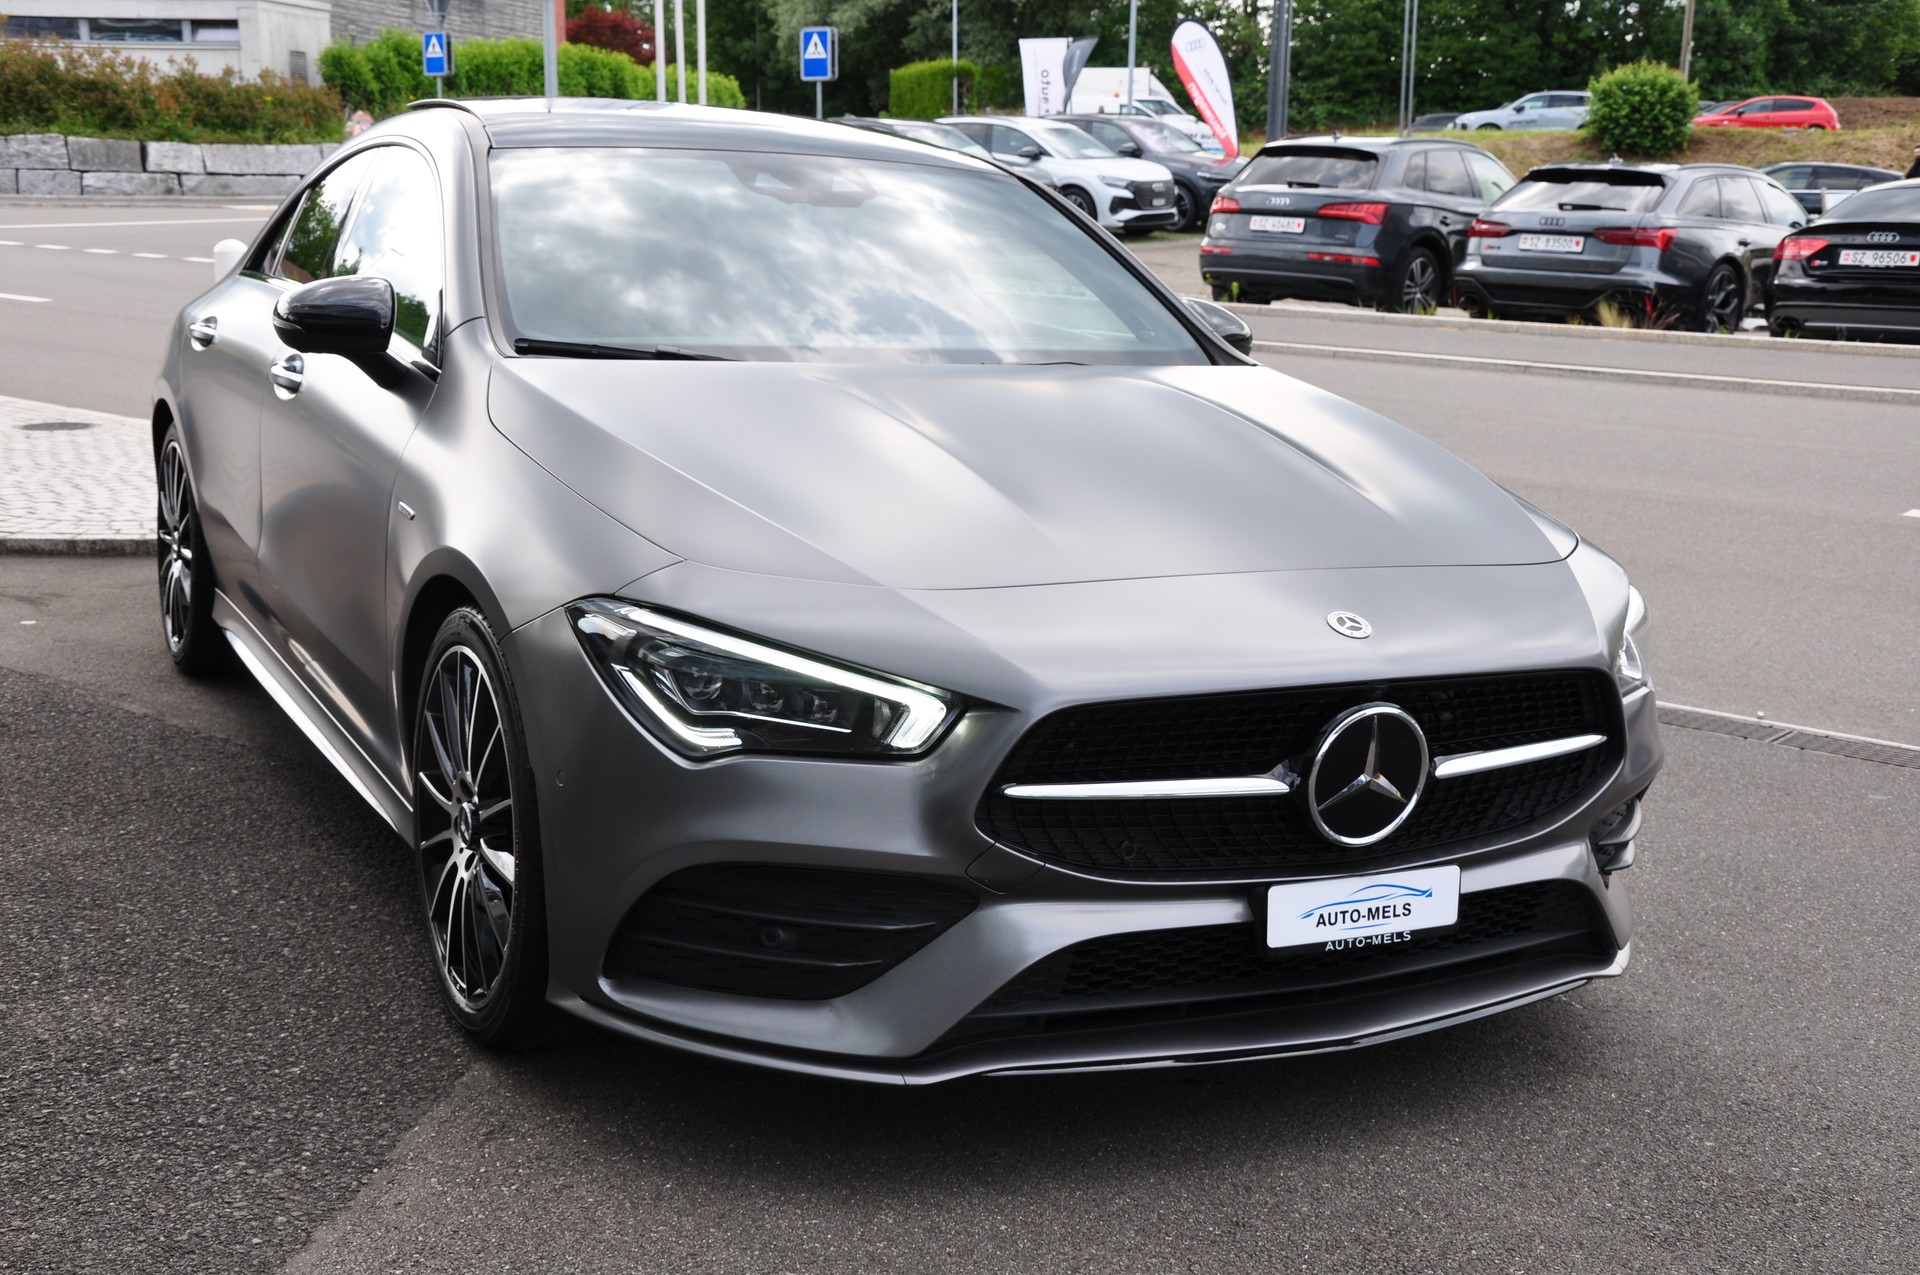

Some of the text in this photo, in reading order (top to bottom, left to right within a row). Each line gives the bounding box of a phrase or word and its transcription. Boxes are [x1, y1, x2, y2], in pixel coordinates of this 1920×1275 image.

[1530, 236, 1541, 248] SZ
[1852, 252, 1907, 264] SZ 96506
[1316, 903, 1412, 928] AUTO-MELS
[1325, 931, 1412, 951] AUTO-MELS
